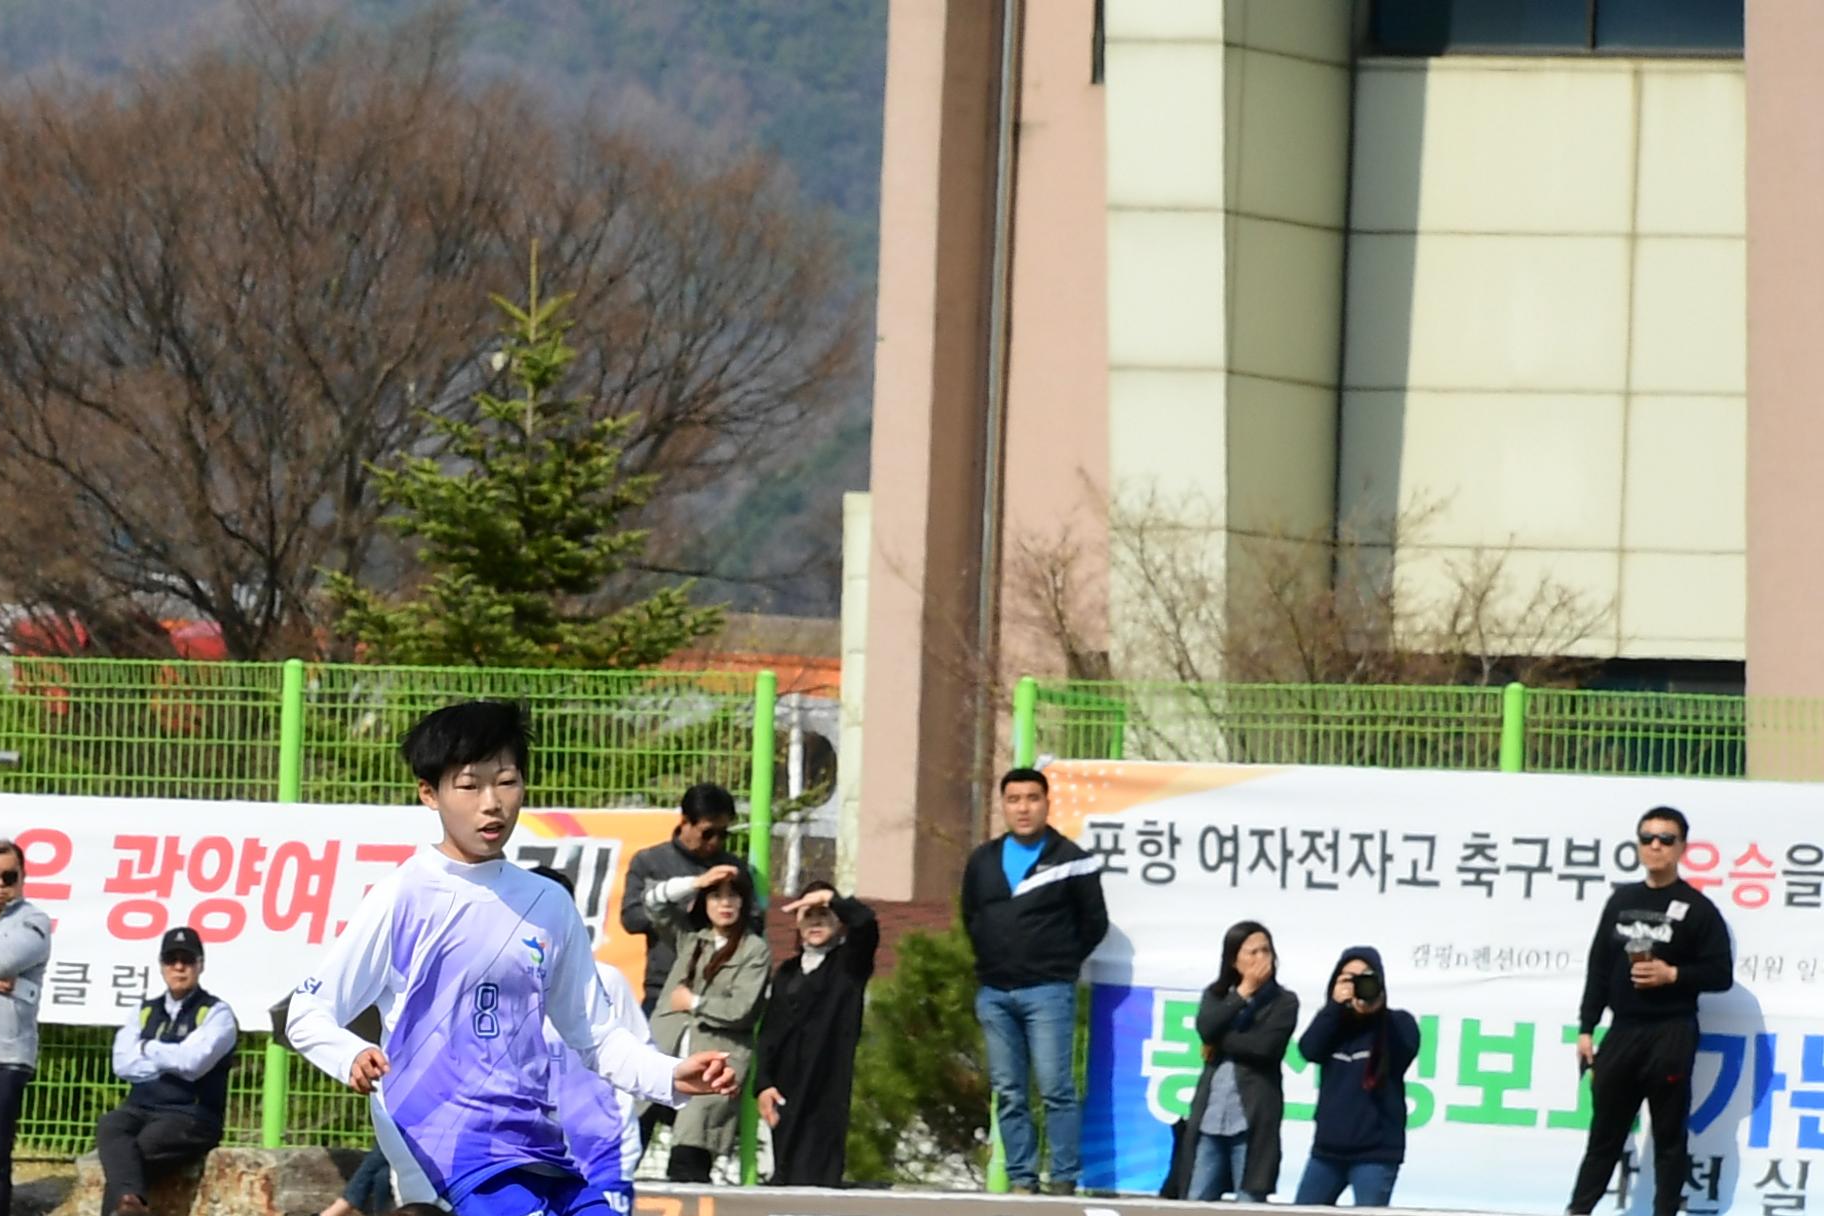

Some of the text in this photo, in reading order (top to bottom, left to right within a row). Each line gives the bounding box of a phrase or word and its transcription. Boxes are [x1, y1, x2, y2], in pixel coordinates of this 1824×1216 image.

[1087, 819, 1182, 885] 포항
[1198, 824, 1441, 894] 여자전자고
[475, 982, 500, 1038] 8
